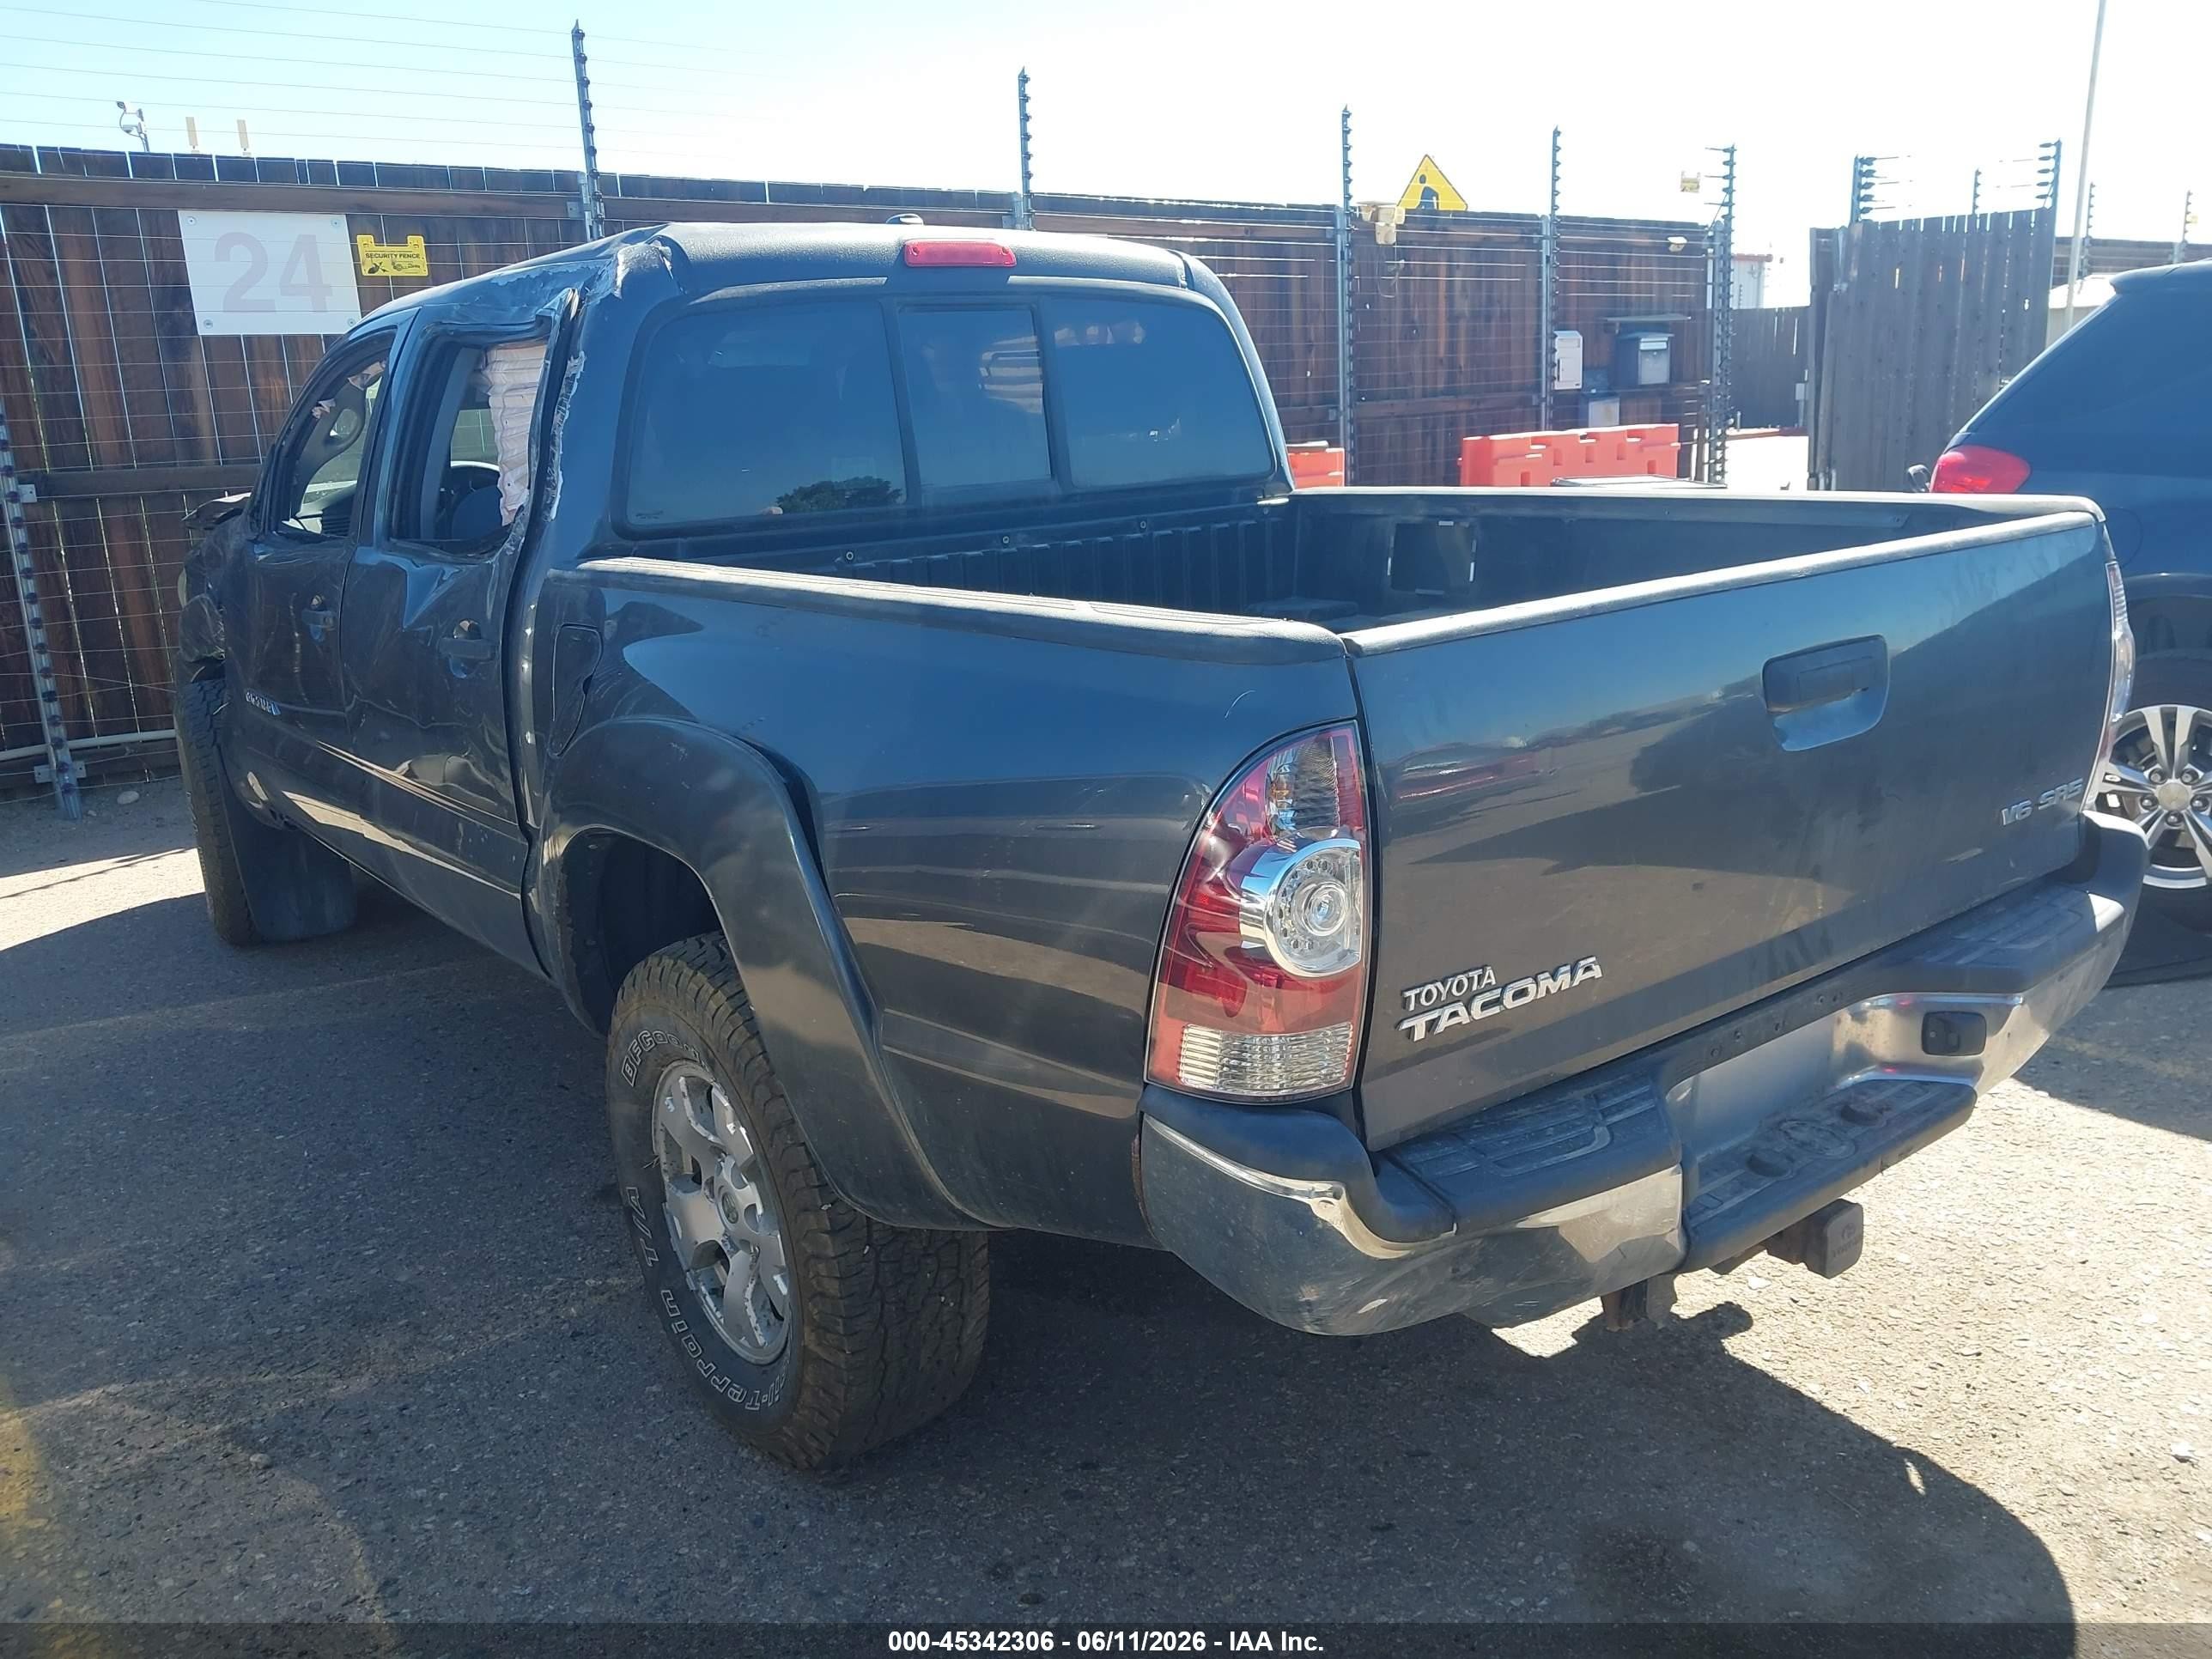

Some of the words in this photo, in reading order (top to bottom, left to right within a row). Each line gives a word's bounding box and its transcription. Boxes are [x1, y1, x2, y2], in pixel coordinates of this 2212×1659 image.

[215, 232, 333, 313] 24
[2001, 799, 2033, 826] V6
[1395, 956, 1604, 1042] TACOMA
[1401, 965, 1497, 1012] TOYOTA
[626, 1187, 659, 1267] T/A
